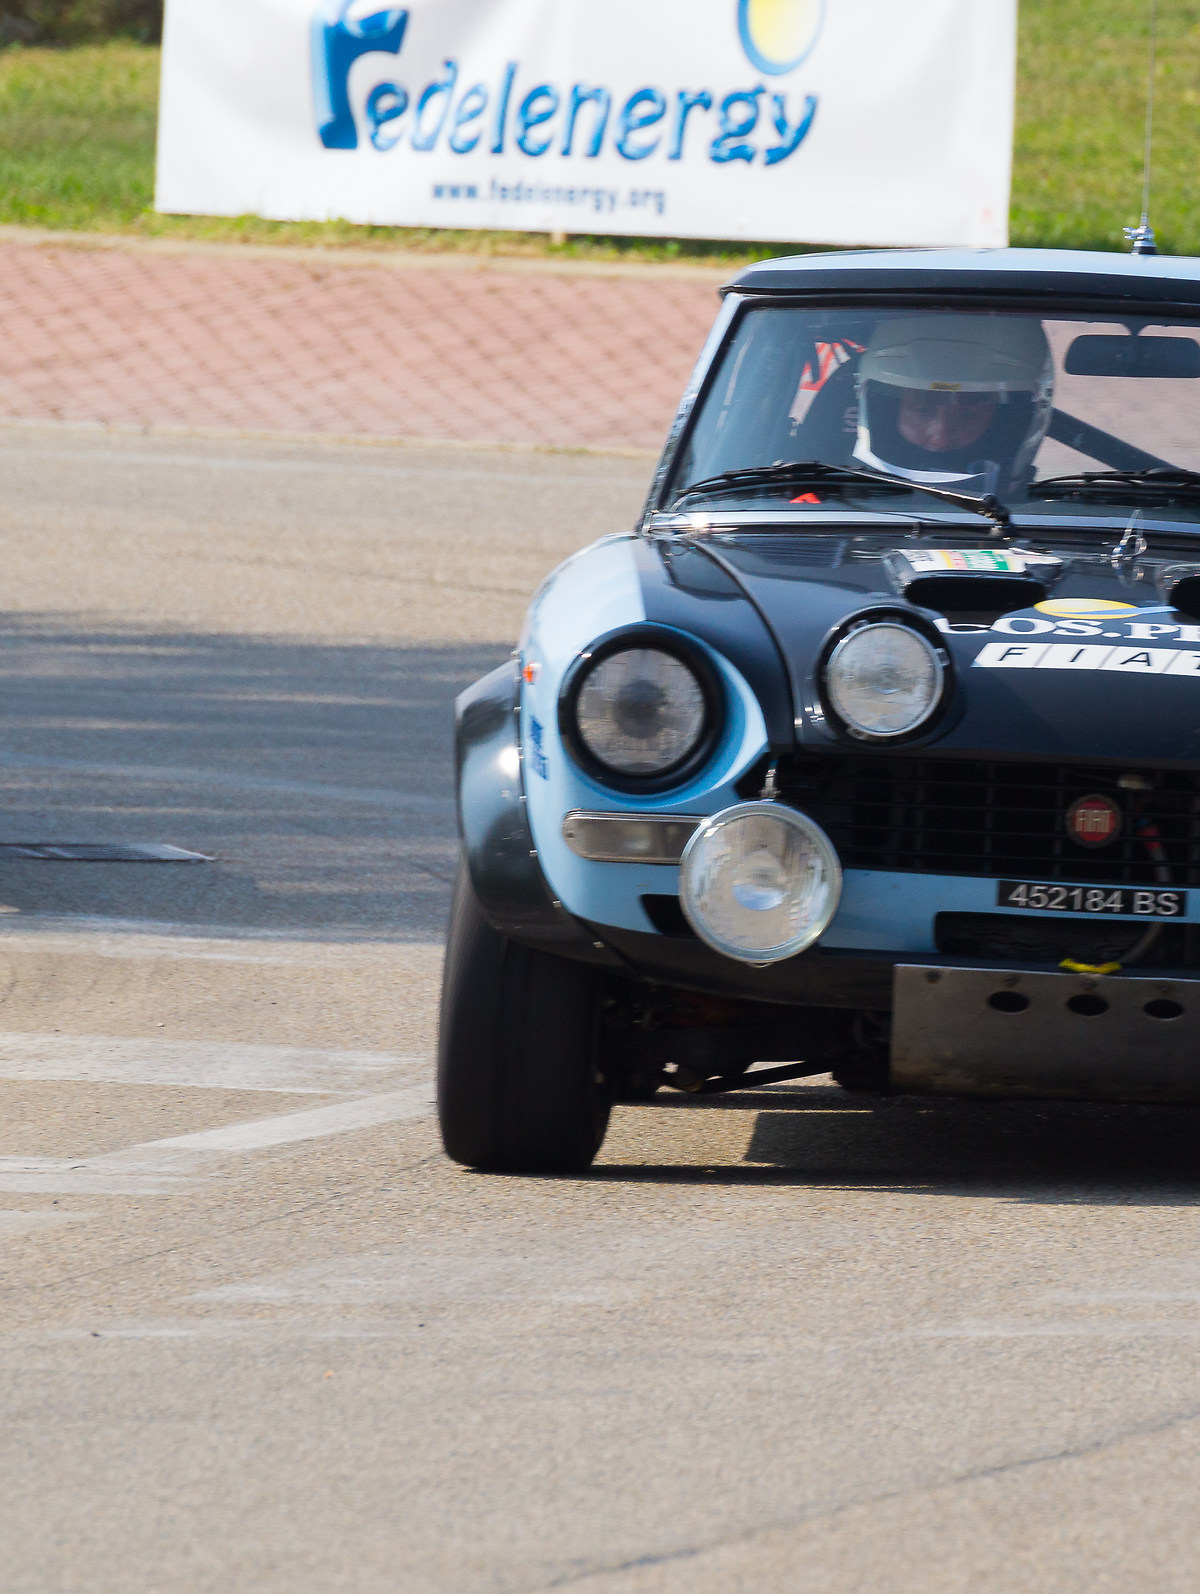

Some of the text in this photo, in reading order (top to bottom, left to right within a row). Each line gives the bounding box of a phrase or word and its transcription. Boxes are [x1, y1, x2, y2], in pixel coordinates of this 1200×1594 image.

[1075, 809, 1112, 833] FIAT
[1008, 883, 1180, 916] 452184 BS
